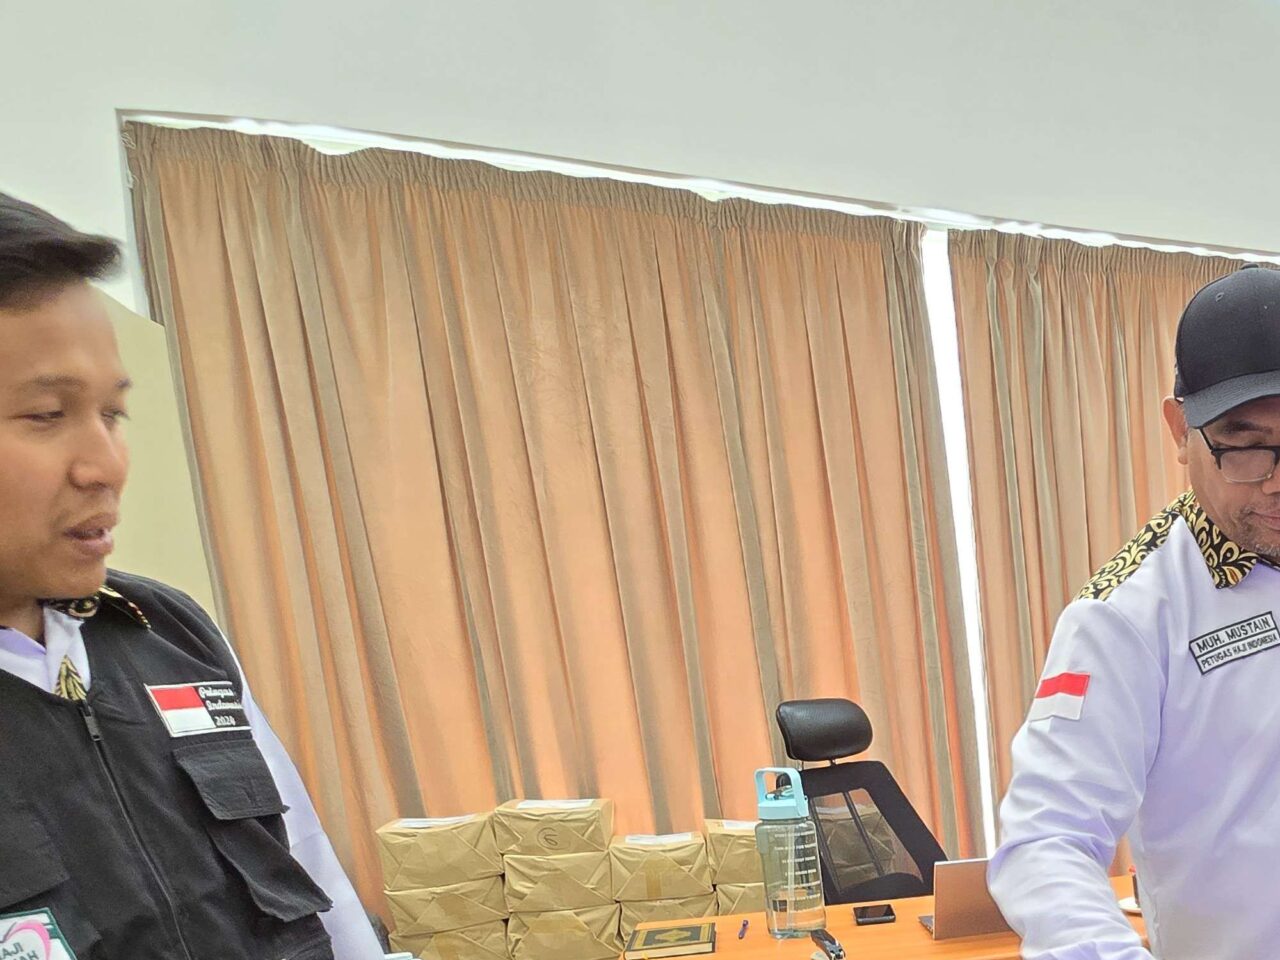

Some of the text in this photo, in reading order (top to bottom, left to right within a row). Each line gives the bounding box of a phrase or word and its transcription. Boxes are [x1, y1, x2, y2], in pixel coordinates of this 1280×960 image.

[1196, 617, 1271, 653] MUH. MUSTAIN
[1201, 633, 1278, 668] PETUGAS HAJI INDONESIA
[0, 942, 24, 960] AJI
